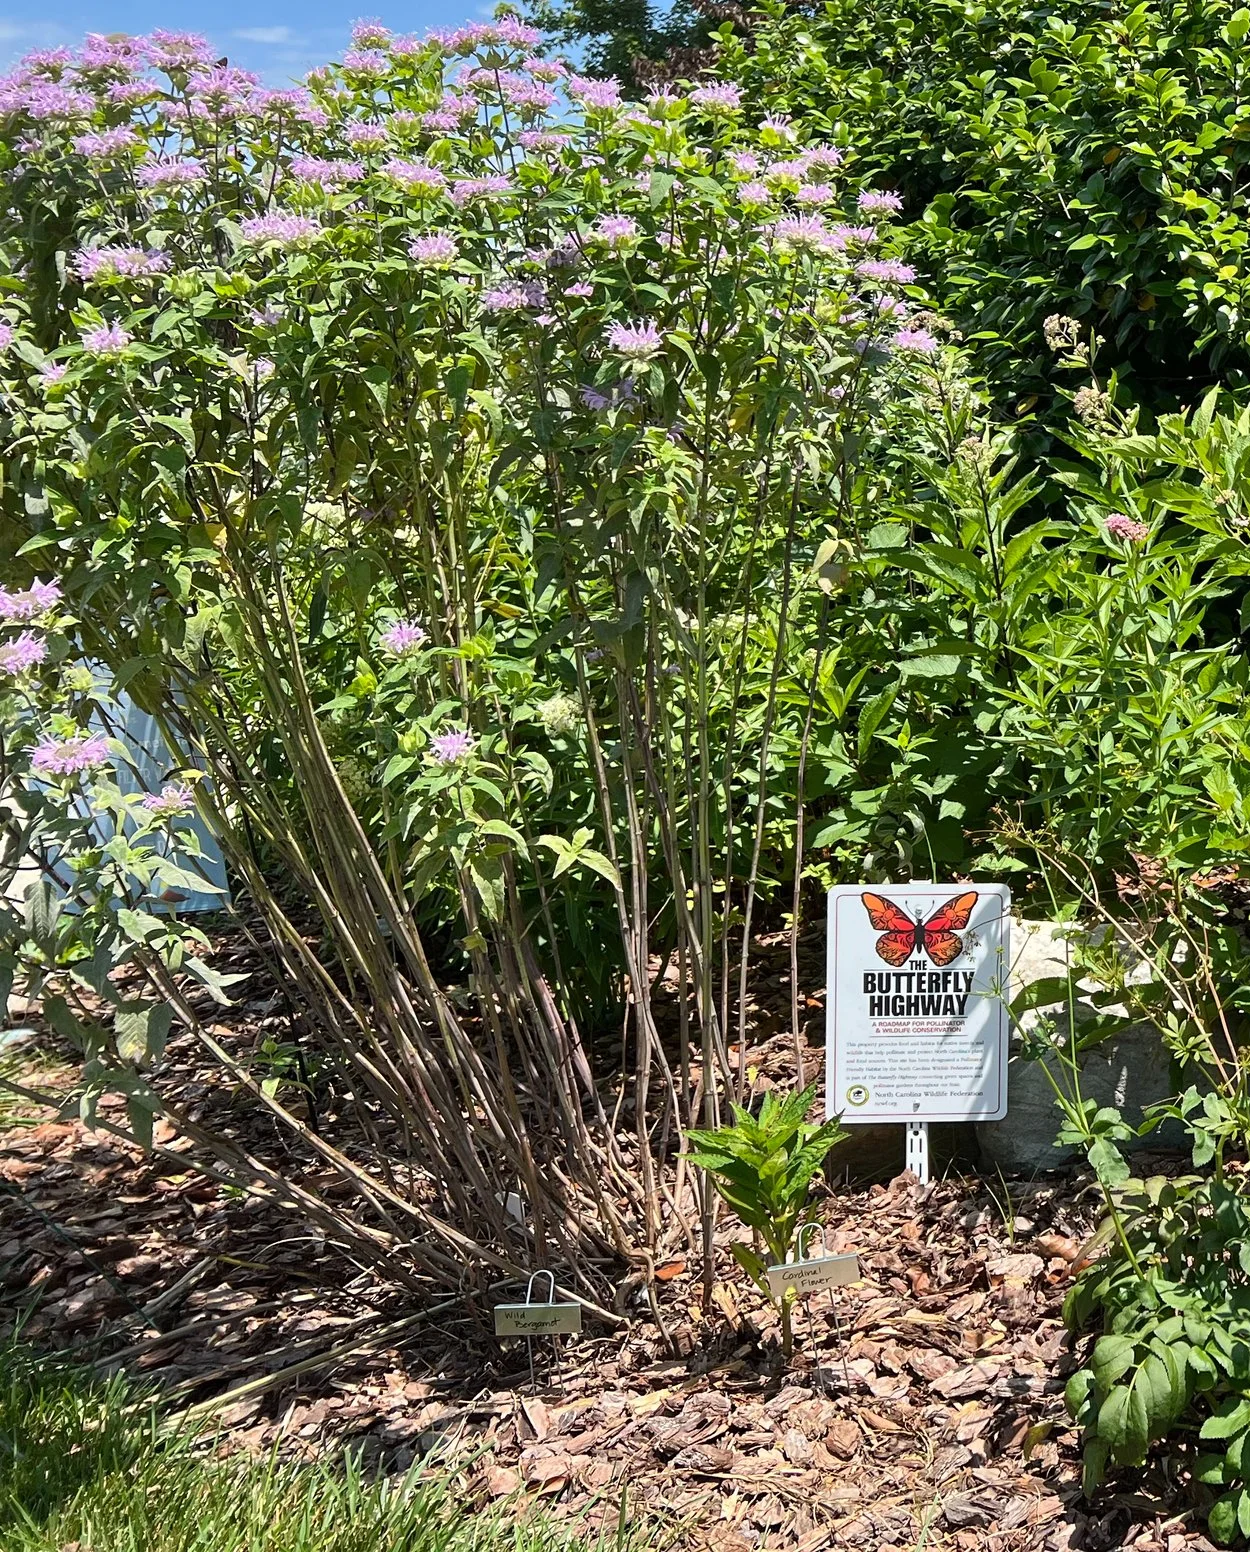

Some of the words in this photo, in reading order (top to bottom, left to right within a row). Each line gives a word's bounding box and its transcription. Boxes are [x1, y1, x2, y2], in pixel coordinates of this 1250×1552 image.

[909, 960, 927, 971] THE
[863, 972, 975, 994] BUTTERFLY
[869, 995, 968, 1017] HIGHWAY
[782, 1267, 821, 1280] Cardinal
[801, 1277, 832, 1287] Flower
